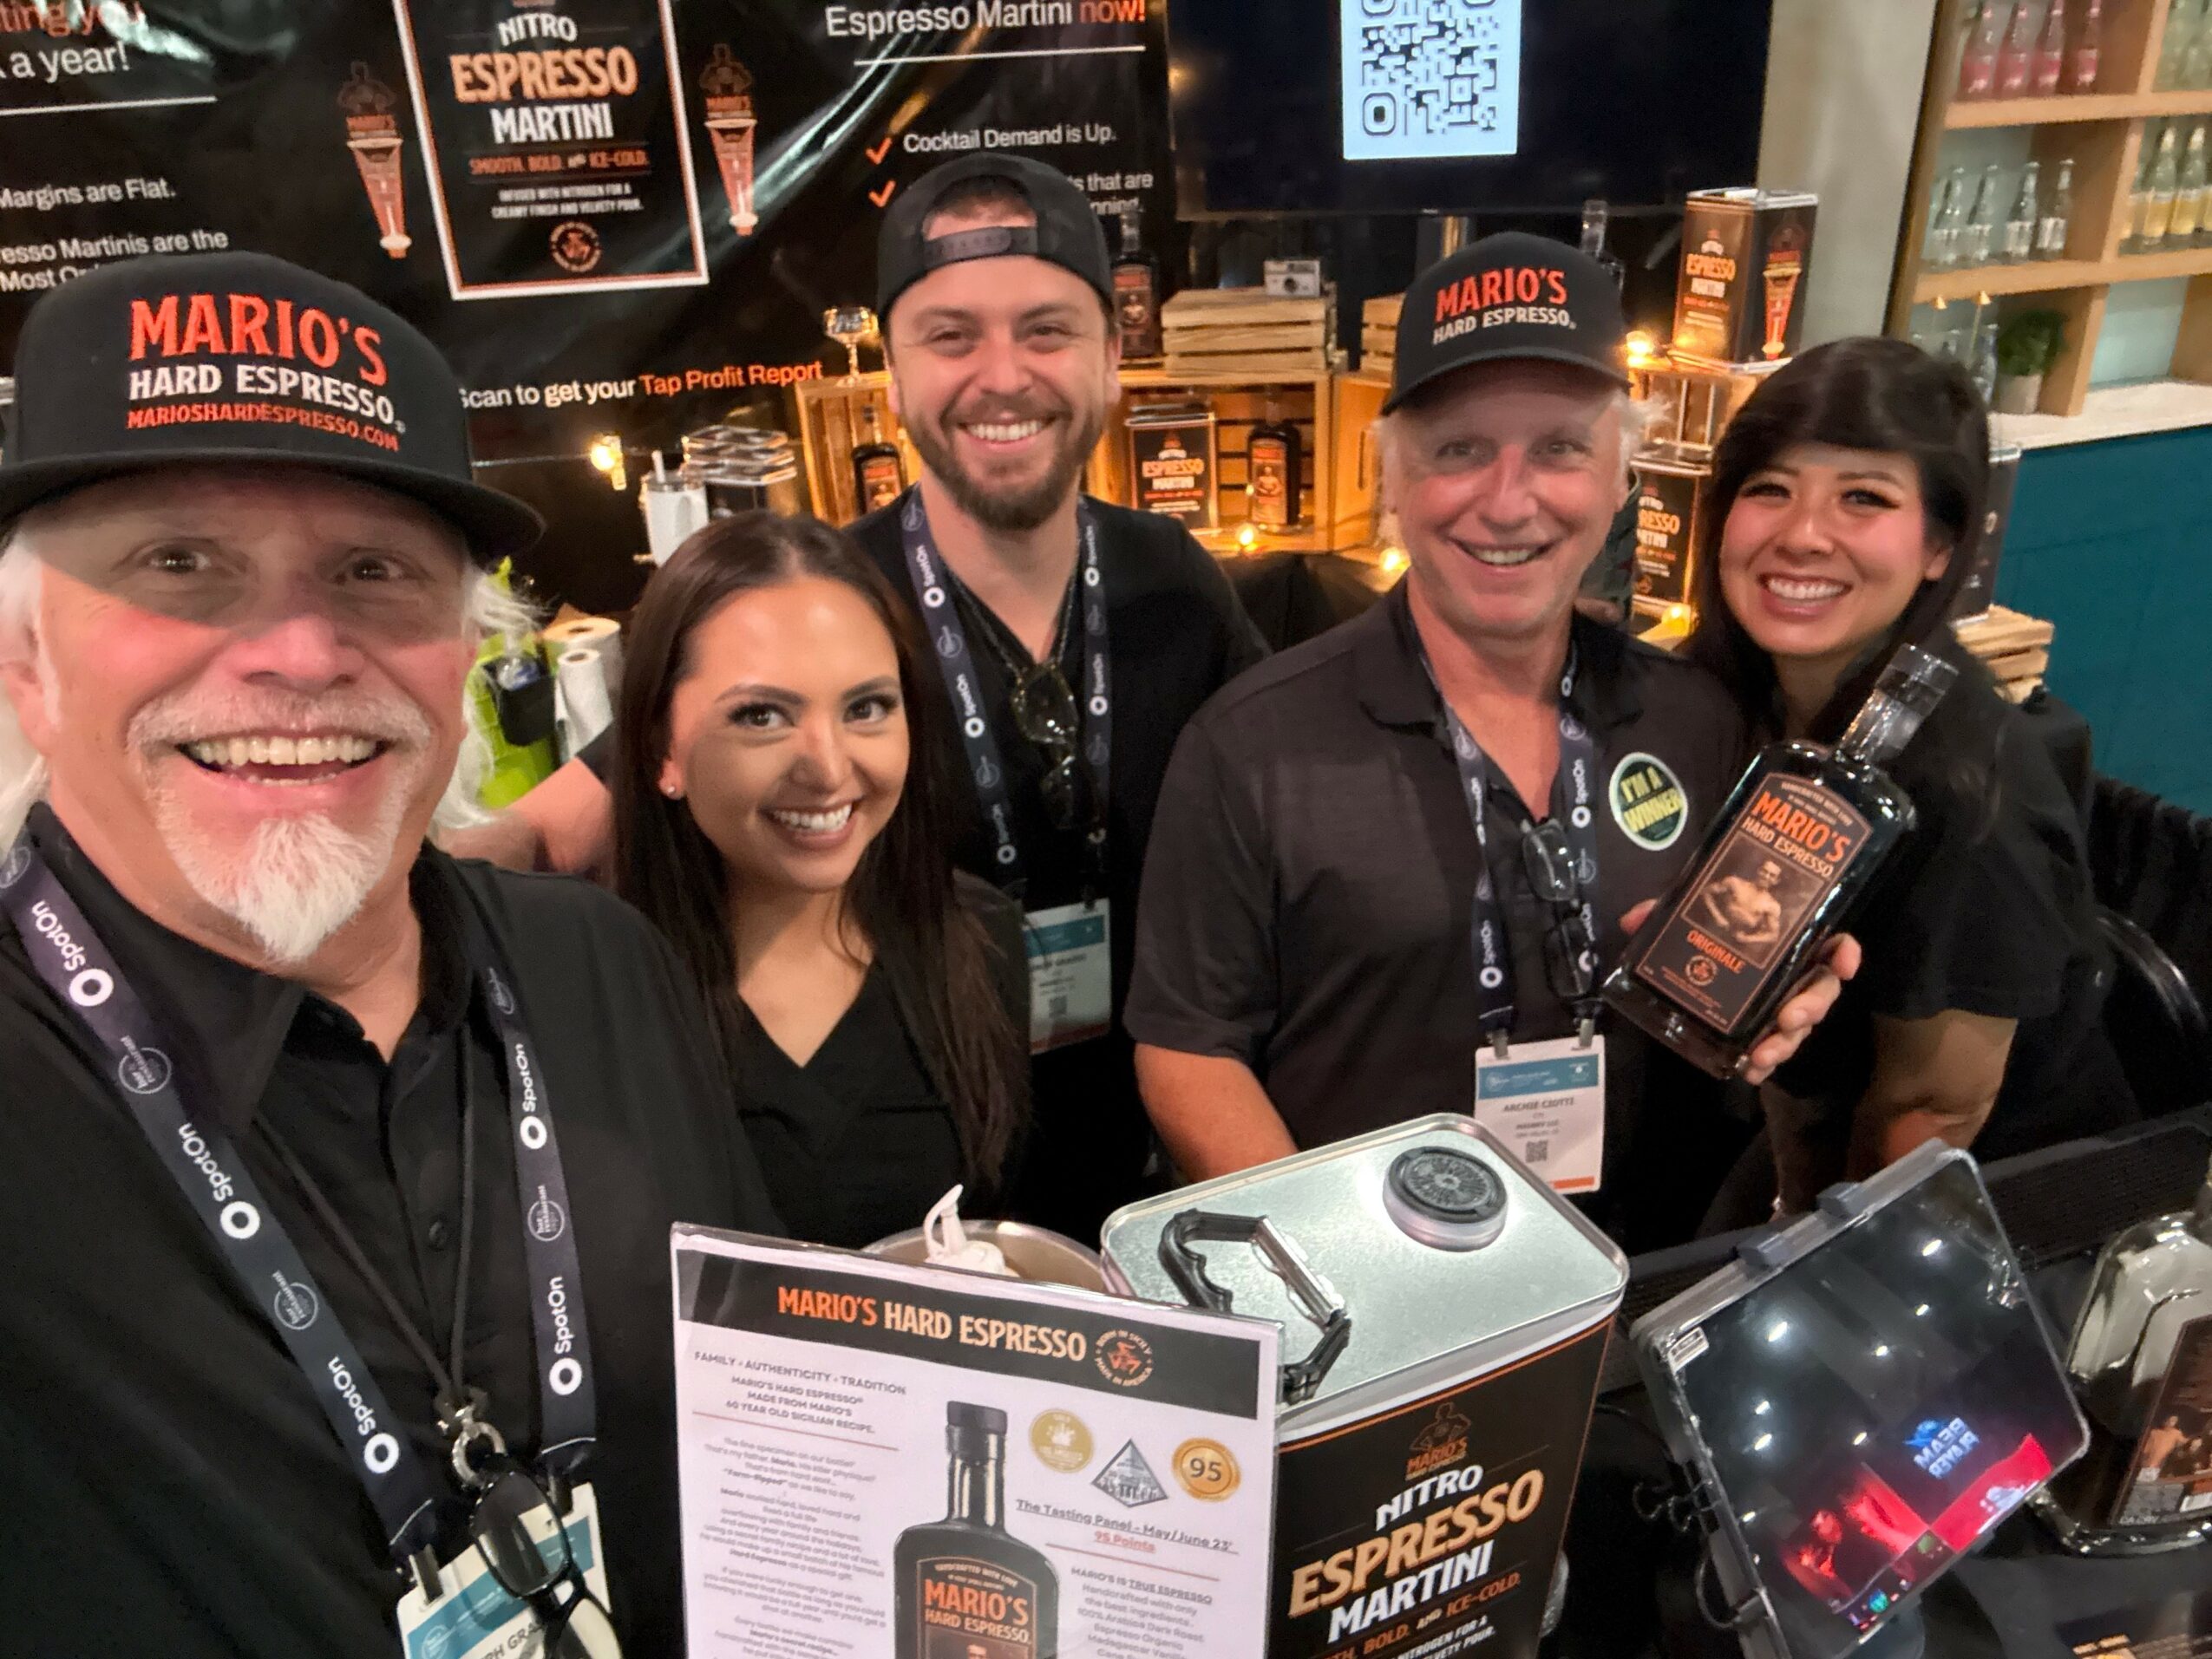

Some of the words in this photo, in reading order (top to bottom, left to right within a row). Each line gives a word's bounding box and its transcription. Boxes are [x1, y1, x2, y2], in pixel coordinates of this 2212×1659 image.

[496, 12, 578, 46] NITRO
[825, 5, 970, 41] Espresso
[977, 0, 1073, 29] Martini
[1079, 0, 1146, 23] now!
[10, 52, 36, 79] a
[38, 40, 130, 83] year!
[448, 46, 639, 104] ESPRESSO
[490, 102, 613, 145] MARTINI
[902, 130, 980, 153] Cocktail
[984, 122, 1063, 148] Demand
[1065, 121, 1082, 142] is
[1084, 120, 1117, 145] Up.
[0, 183, 84, 211] Margins
[86, 184, 123, 203] are
[125, 178, 177, 200] Flat.
[1087, 173, 1122, 192] that
[1124, 173, 1154, 189] are
[58, 234, 149, 258] Martinis
[153, 232, 190, 251] are
[192, 229, 229, 250] the
[0, 268, 56, 292] Most
[1436, 266, 1568, 323] MARIO'S
[129, 292, 387, 386] MARIO'S
[1432, 316, 1477, 346] HARD
[128, 364, 222, 401] HARD
[515, 384, 540, 405] to
[545, 382, 583, 408] get
[587, 379, 637, 407] your
[639, 374, 683, 396] Tap
[685, 365, 745, 390] Profit
[749, 361, 823, 387] Report
[127, 402, 399, 452] MARIOSHARDESPRESSO.COM
[1142, 458, 1205, 478] ESPRESSO
[1646, 766, 1663, 789] A
[1623, 787, 1685, 833] WINNER
[1752, 791, 1851, 863] MARIO'S
[1741, 817, 1776, 845] HARD
[1774, 838, 1835, 878] ESPRESSO
[32, 900, 86, 971] SpotOn
[1685, 930, 1747, 974] ORIGINALE
[514, 1043, 538, 1113] SpotOn
[179, 1122, 233, 1203] SpotOn
[547, 1276, 574, 1355] SpotOn
[777, 1286, 878, 1326] MARIO'S
[883, 1301, 952, 1340] HARD
[959, 1315, 1087, 1362] ESPRESSO
[693, 1351, 736, 1367] FAMILY
[745, 1360, 832, 1382] AUTHENTICITY
[841, 1375, 907, 1394] TRADITION
[327, 1355, 376, 1436] SpotOn
[1189, 1458, 1222, 1482] 95
[1406, 1436, 1469, 1473] MARIO'S
[1376, 1465, 1484, 1532] NITRO
[1015, 1500, 1041, 1515] The
[1042, 1506, 1093, 1525] Tasting
[1094, 1515, 1131, 1532] Panel
[1142, 1525, 1210, 1545] May/June
[1094, 1532, 1110, 1544] 95
[1113, 1535, 1156, 1552] Points
[1288, 1469, 1544, 1619] ESPRESSO
[925, 1578, 1029, 1625] MARIO'S
[1327, 1539, 1495, 1643] MARTINI
[925, 1609, 961, 1628] HARD
[1416, 1609, 1443, 1630] AND
